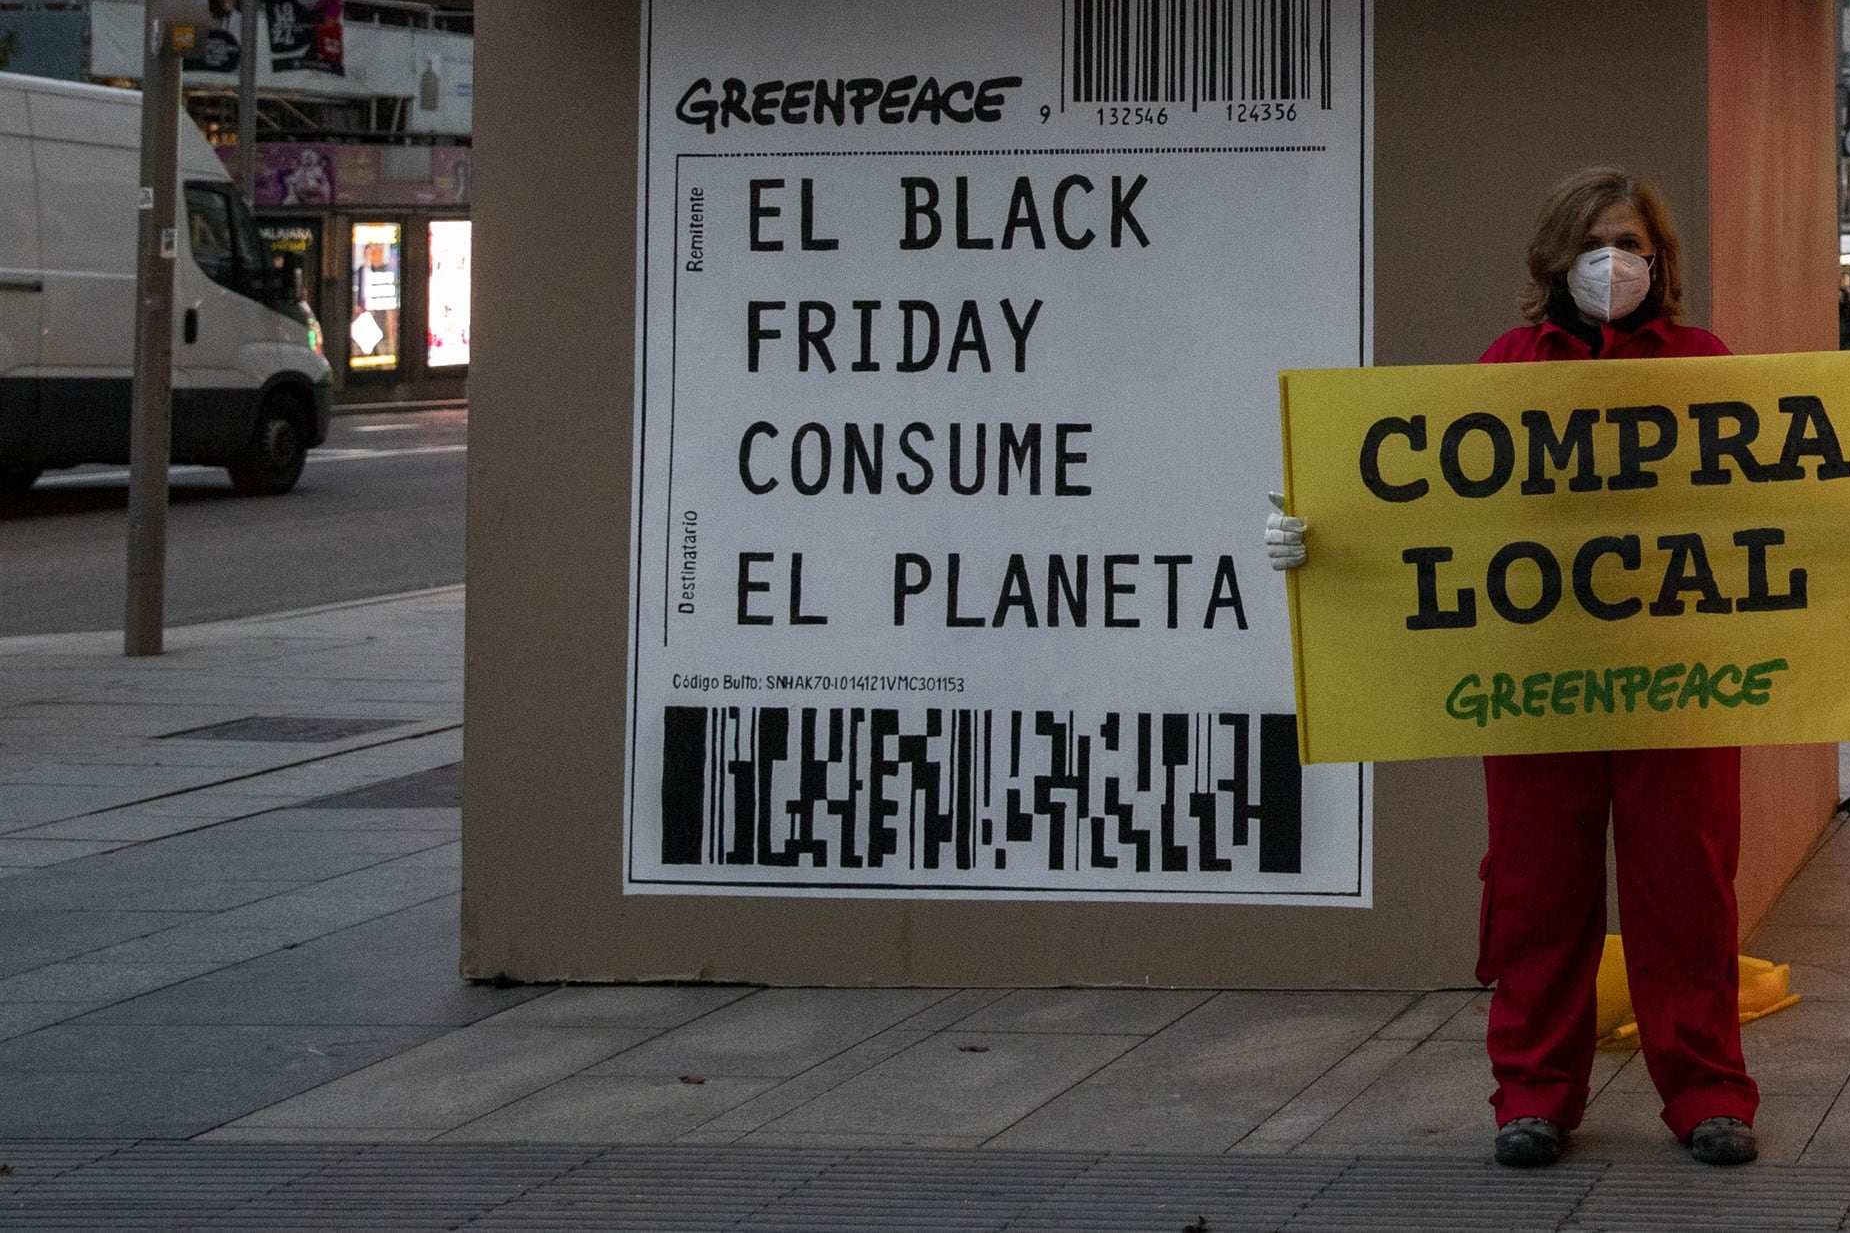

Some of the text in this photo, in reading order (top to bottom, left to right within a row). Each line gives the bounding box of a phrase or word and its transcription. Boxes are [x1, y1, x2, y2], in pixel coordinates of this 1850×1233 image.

[676, 75, 1023, 135] GREENPEACE
[1039, 103, 1297, 126] 9 132546 124356
[686, 186, 705, 272] Remitente
[750, 174, 1150, 252] EL BLACK
[748, 298, 1043, 374] FRIDAY
[738, 421, 1093, 497] CONSUME
[678, 510, 699, 615] Destinatario
[737, 551, 1249, 631] EL PLANETA
[1402, 527, 1808, 631] LOCAL
[672, 673, 720, 693] Código
[723, 674, 762, 692] Bulto:
[1444, 658, 1788, 728] GREENPEACE
